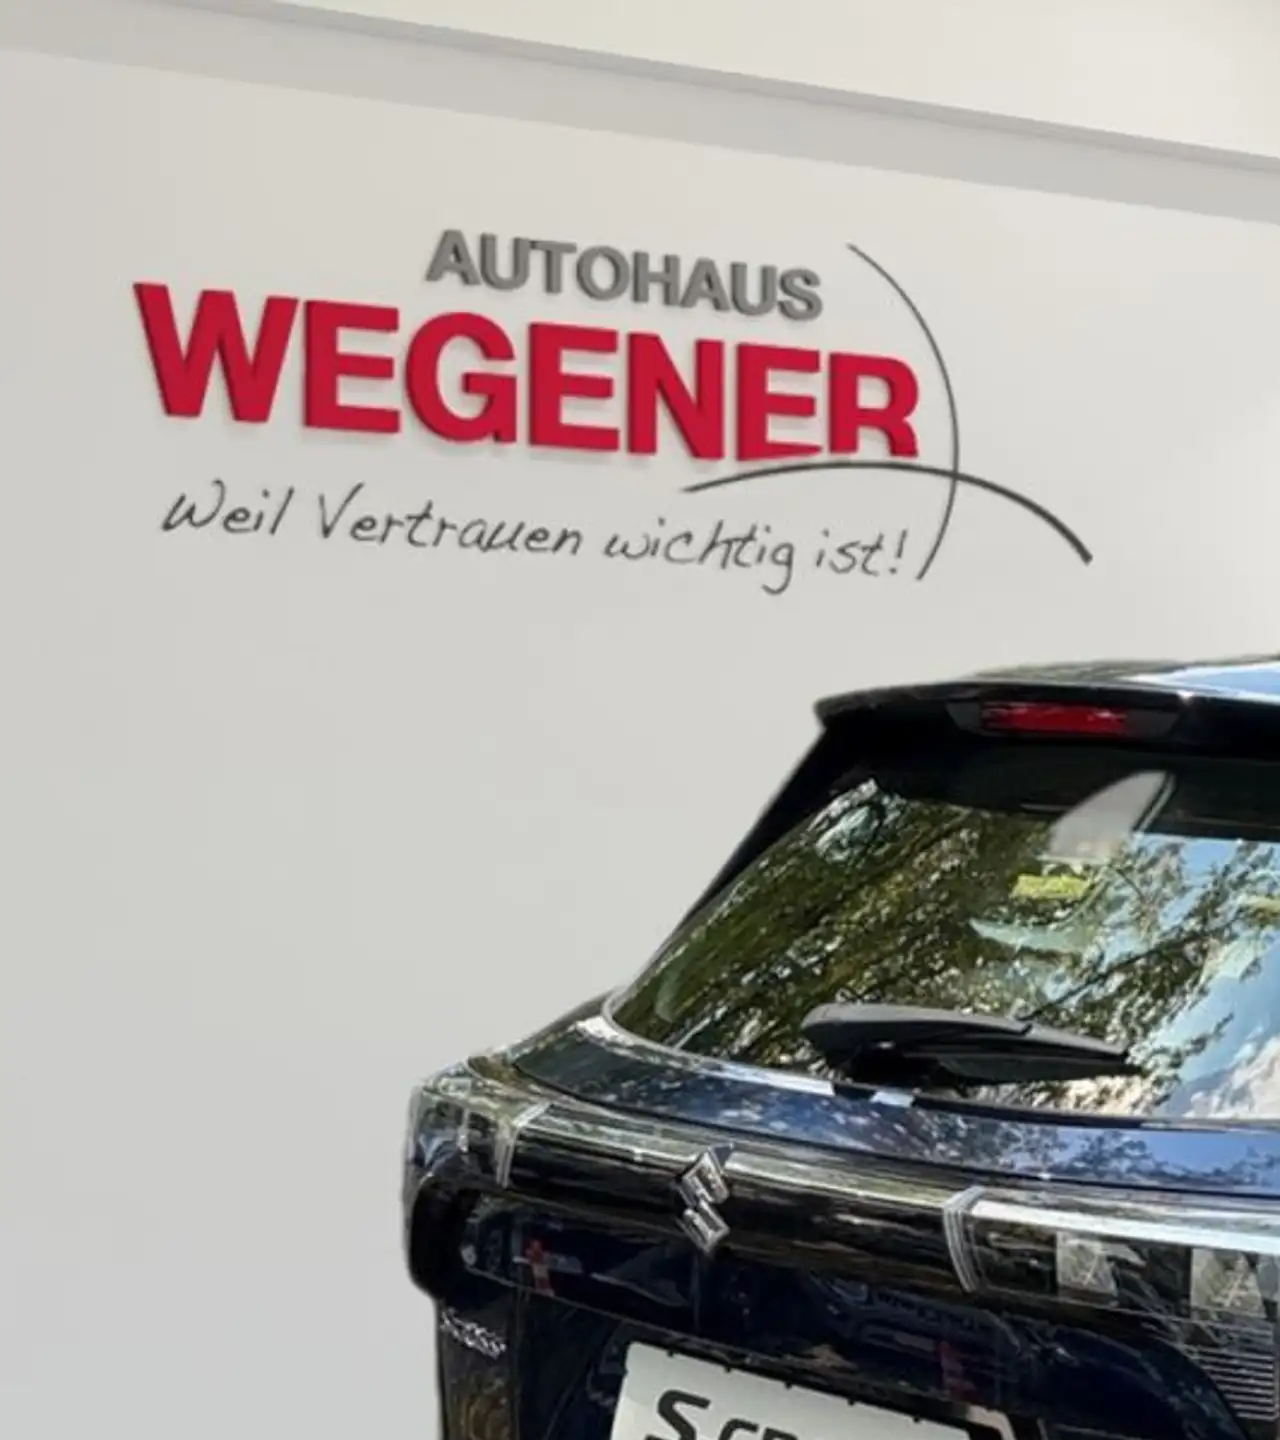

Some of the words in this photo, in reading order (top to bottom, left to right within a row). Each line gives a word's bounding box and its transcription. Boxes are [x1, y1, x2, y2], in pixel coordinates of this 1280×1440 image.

[426, 229, 822, 321] AUTOHAUS
[134, 281, 919, 463] WEGENER
[162, 480, 294, 538] Weil
[317, 482, 583, 559] Vertrauen
[602, 527, 796, 596] wichtig
[813, 529, 908, 576] ist!
